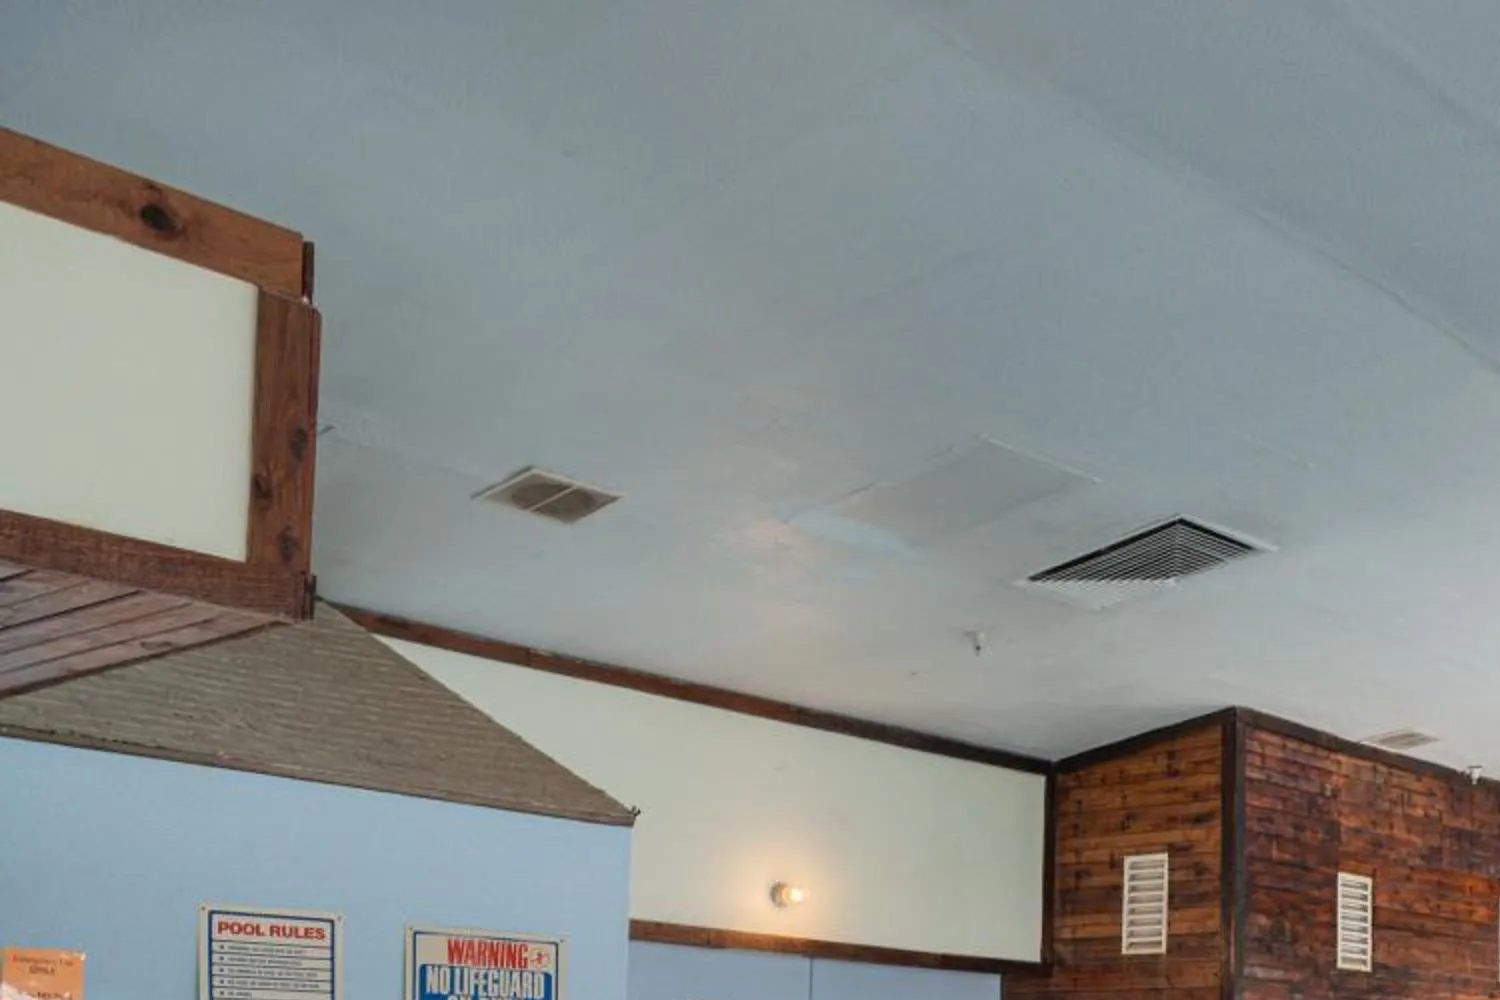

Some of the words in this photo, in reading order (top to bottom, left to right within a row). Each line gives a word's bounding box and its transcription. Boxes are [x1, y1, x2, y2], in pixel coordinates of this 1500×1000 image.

[217, 920, 264, 937] POOL
[269, 924, 325, 940] RULES
[447, 939, 529, 968] WARNING
[425, 965, 450, 994] NO
[453, 967, 546, 1000] LIFEGUARD
